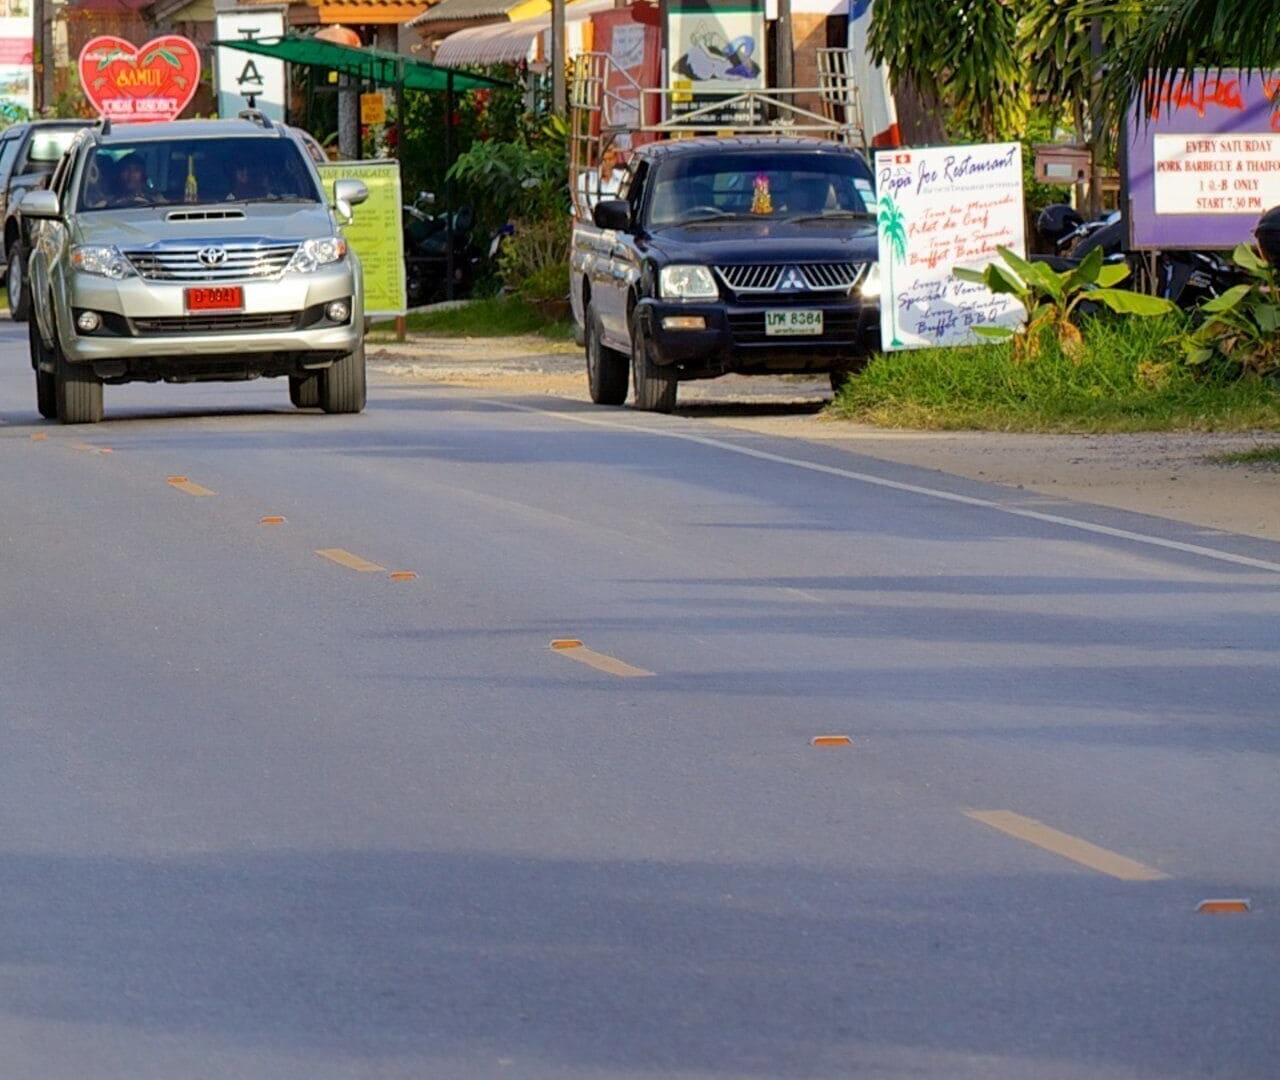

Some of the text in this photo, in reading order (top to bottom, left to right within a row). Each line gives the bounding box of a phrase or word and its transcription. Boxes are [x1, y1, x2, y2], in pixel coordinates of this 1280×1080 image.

[1185, 140, 1273, 153] EVERY SATURDAY
[1157, 160, 1182, 172] PORK
[1185, 160, 1231, 172] BARBECUE
[879, 146, 1017, 200] Papa Joe Restaurant
[1234, 179, 1259, 191] ONLY
[1196, 197, 1225, 209] START
[1248, 197, 1262, 208] PM
[897, 287, 947, 312] Special
[915, 309, 999, 338] Buffet BBQ
